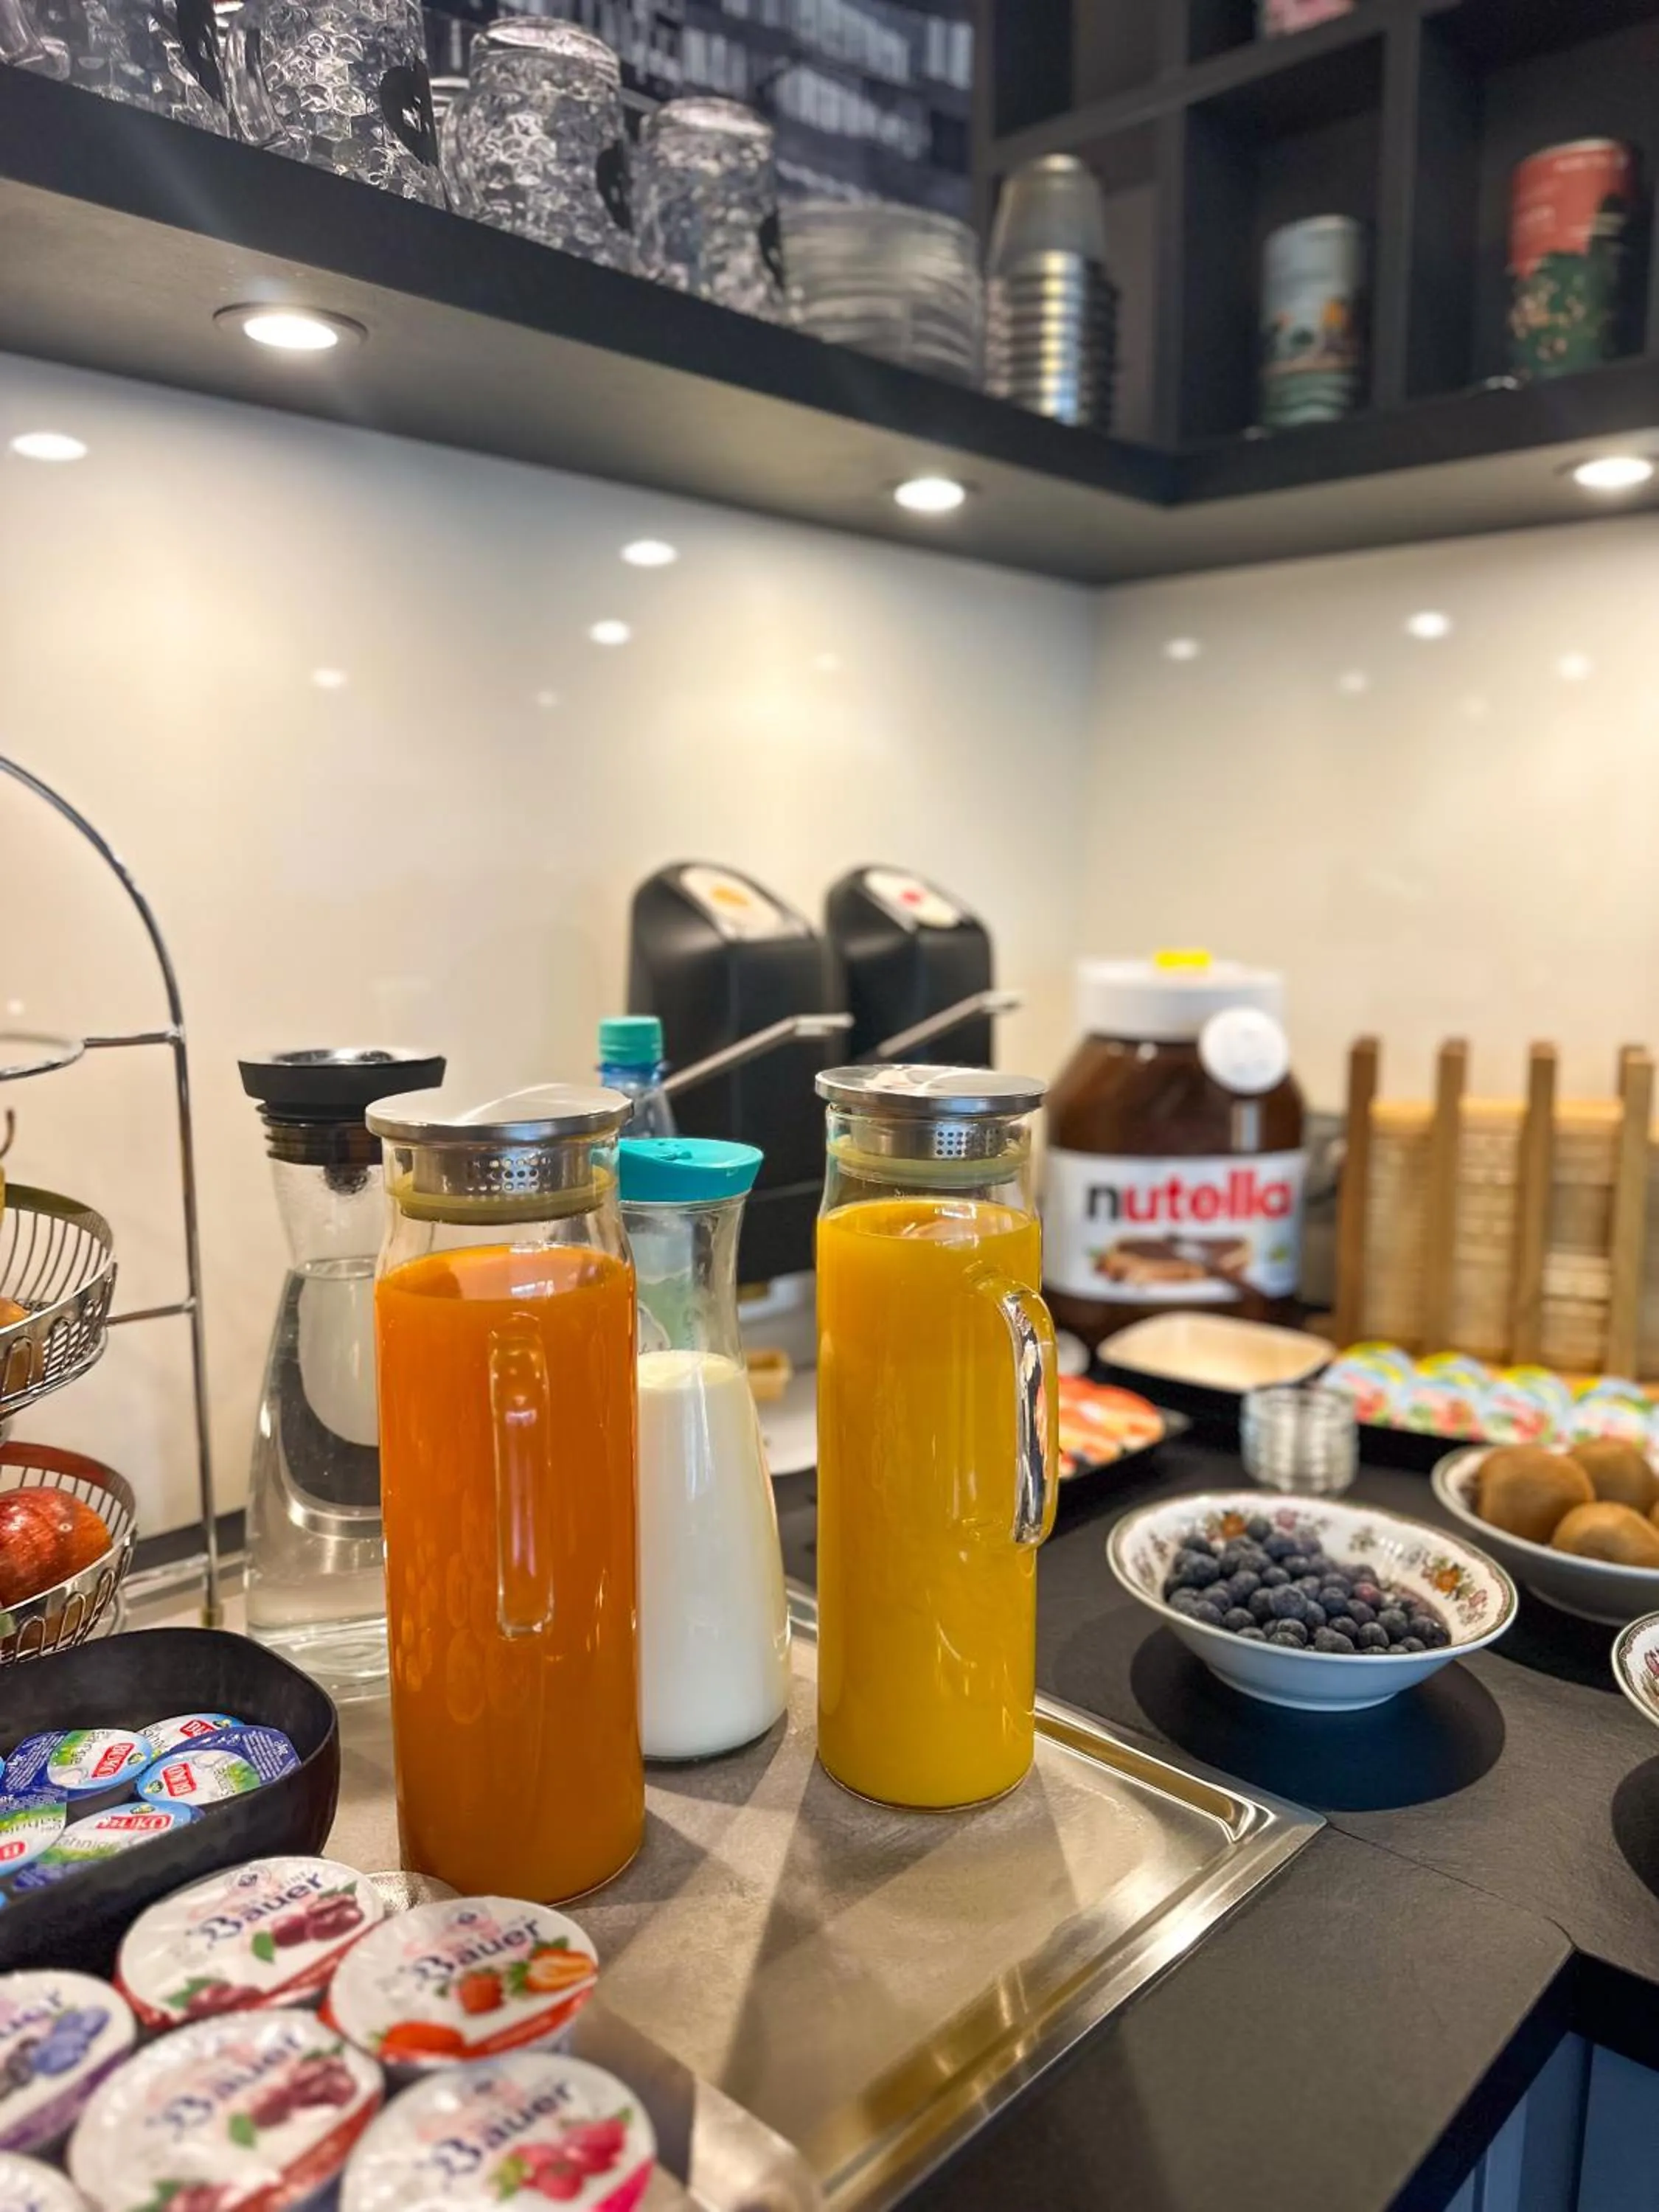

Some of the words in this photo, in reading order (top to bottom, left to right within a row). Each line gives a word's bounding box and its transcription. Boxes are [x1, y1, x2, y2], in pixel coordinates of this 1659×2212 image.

[1087, 1166, 1293, 1222] nutella
[186, 1871, 324, 1950] Bauer
[399, 1917, 543, 1989] Bauer
[145, 2030, 302, 2141] Bauer
[414, 2079, 574, 2190] Bauer
